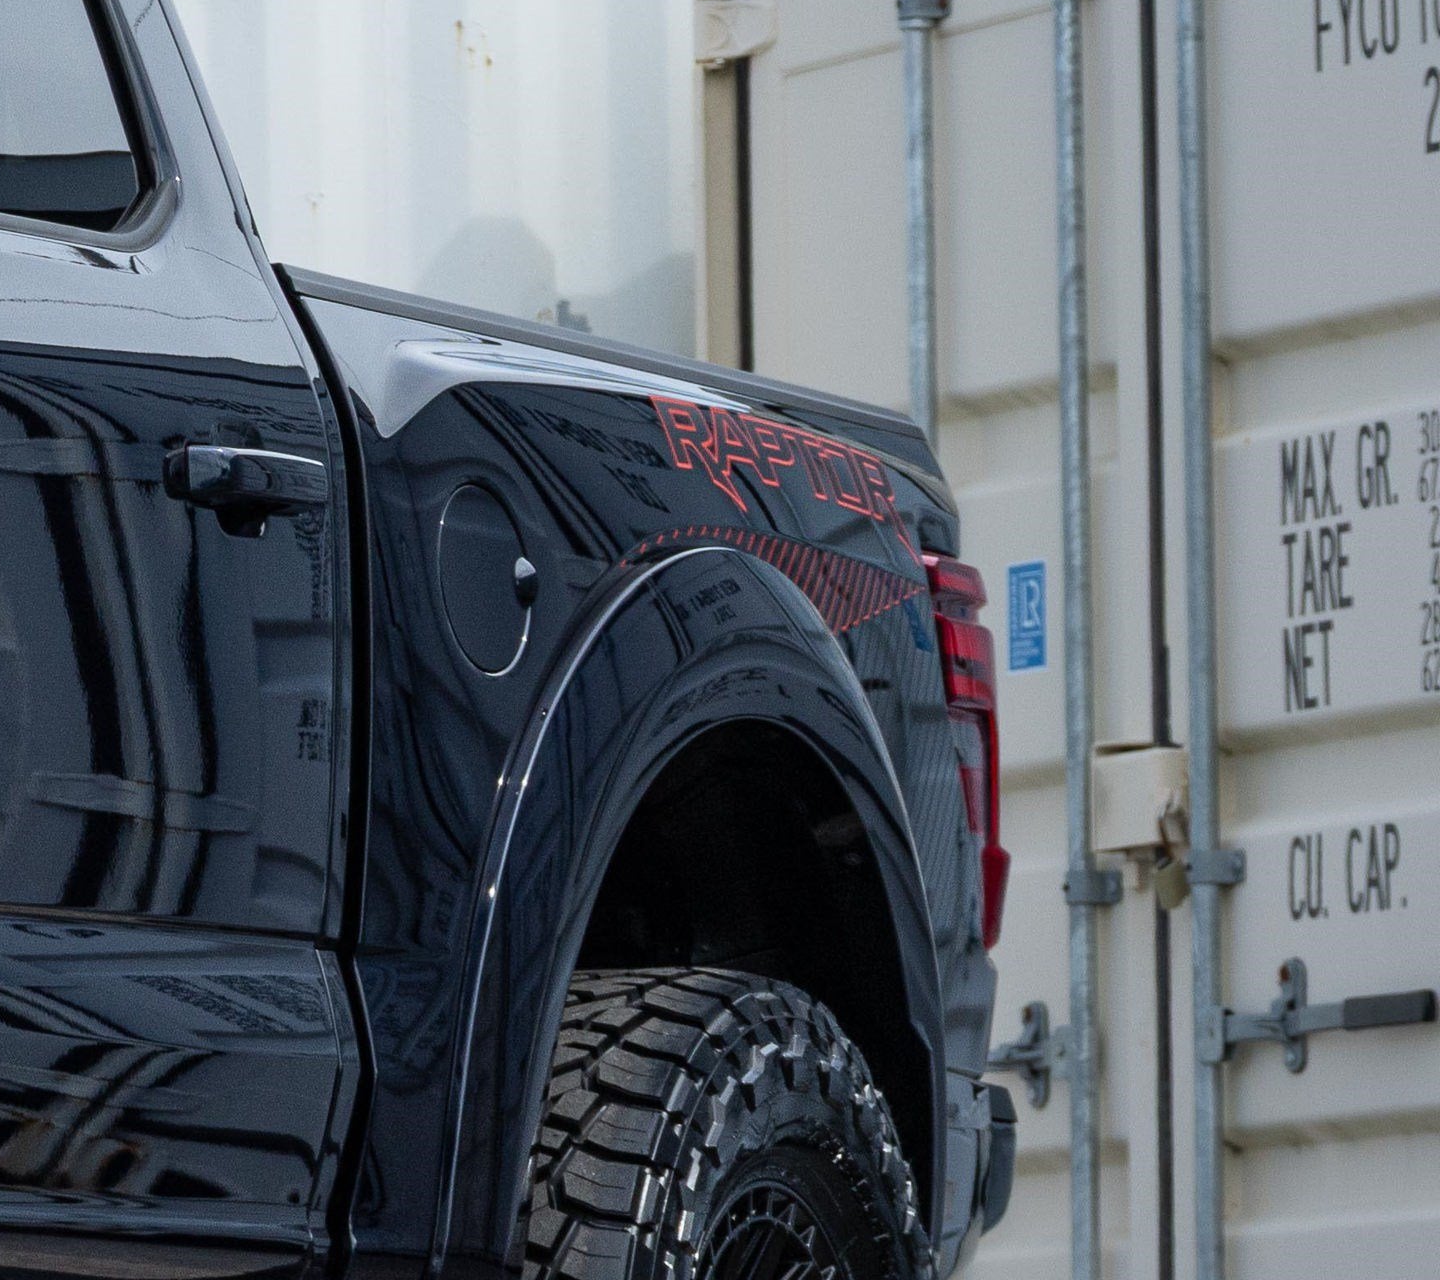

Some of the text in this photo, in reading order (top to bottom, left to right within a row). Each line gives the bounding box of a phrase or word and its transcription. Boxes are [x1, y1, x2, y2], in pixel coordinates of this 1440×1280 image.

[649, 394, 923, 567] RAPTOR
[1282, 421, 1399, 525] MAX. GR.
[1282, 522, 1354, 618] TARE
[1283, 620, 1334, 712] NET
[1288, 823, 1408, 920] CU. CAP.
